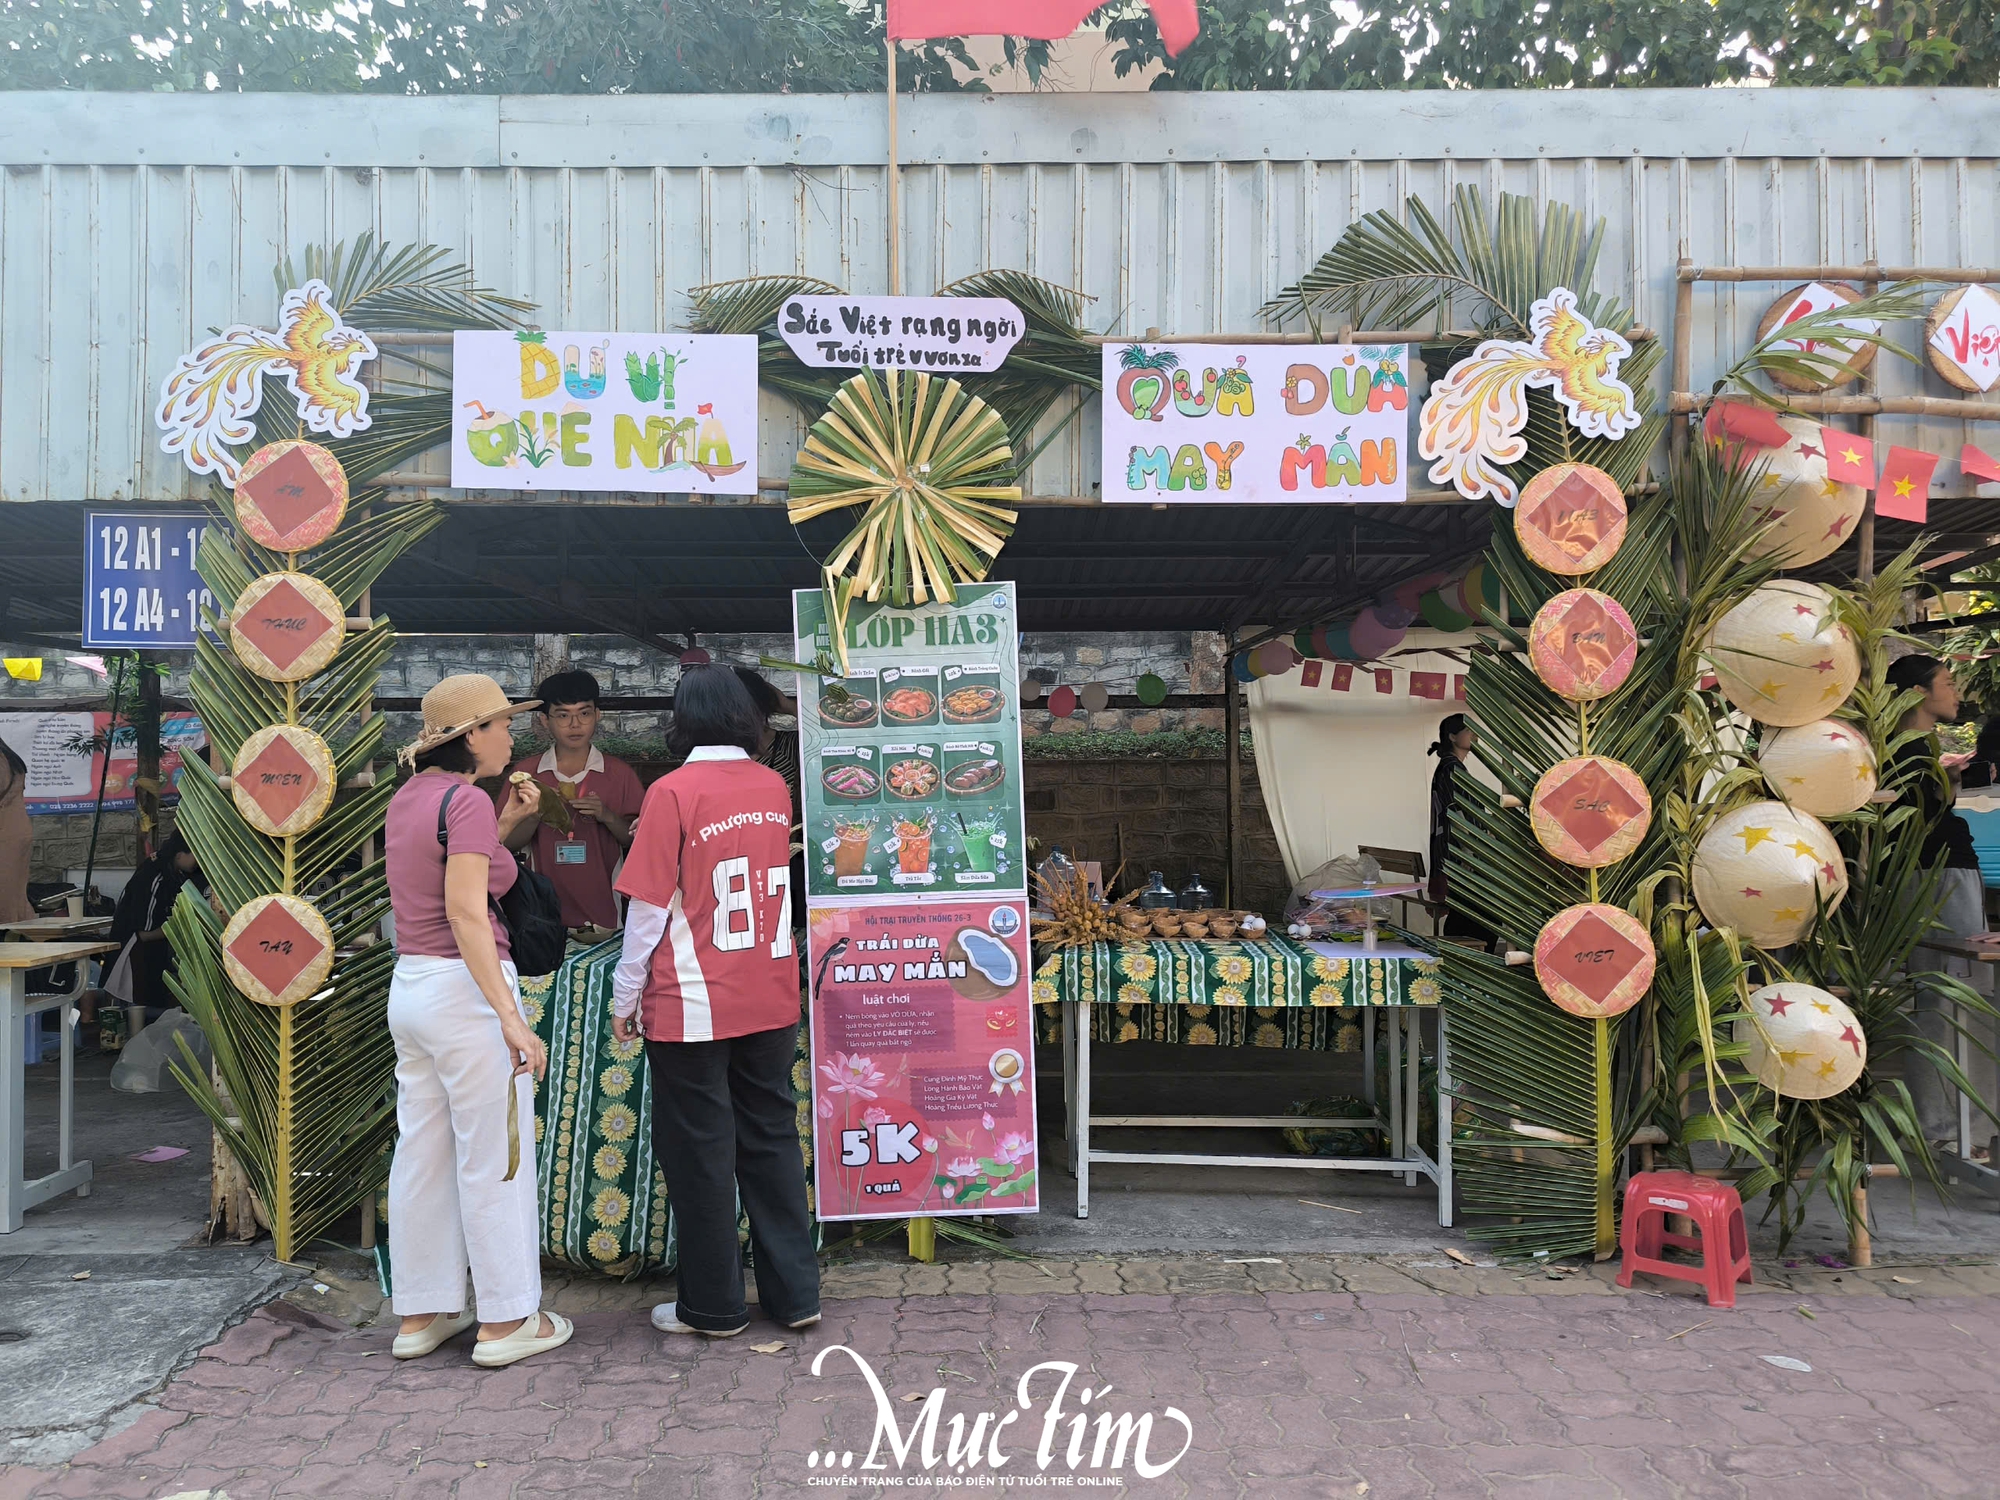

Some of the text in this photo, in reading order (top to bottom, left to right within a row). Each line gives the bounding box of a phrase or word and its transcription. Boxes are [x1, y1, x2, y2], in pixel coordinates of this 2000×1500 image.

[839, 306, 892, 339] Việt
[901, 316, 962, 344] rạng
[967, 316, 1017, 344] ngời
[817, 340, 869, 365] Tuổi
[874, 343, 905, 365] trẻ
[1126, 441, 1244, 491] MAY
[101, 526, 128, 570] 12
[135, 526, 161, 570] A1
[100, 587, 127, 631] 12
[134, 587, 164, 631] A4
[925, 613, 999, 646] 11A3
[699, 812, 763, 842] Phượng
[865, 913, 972, 927] HỘI TRẠI TRUYỀN THỐNG 26-3
[856, 933, 898, 951] TRÁI
[834, 962, 897, 984] MAY
[862, 993, 910, 1006] luật chơi
[874, 1179, 902, 1195] QUẢ
